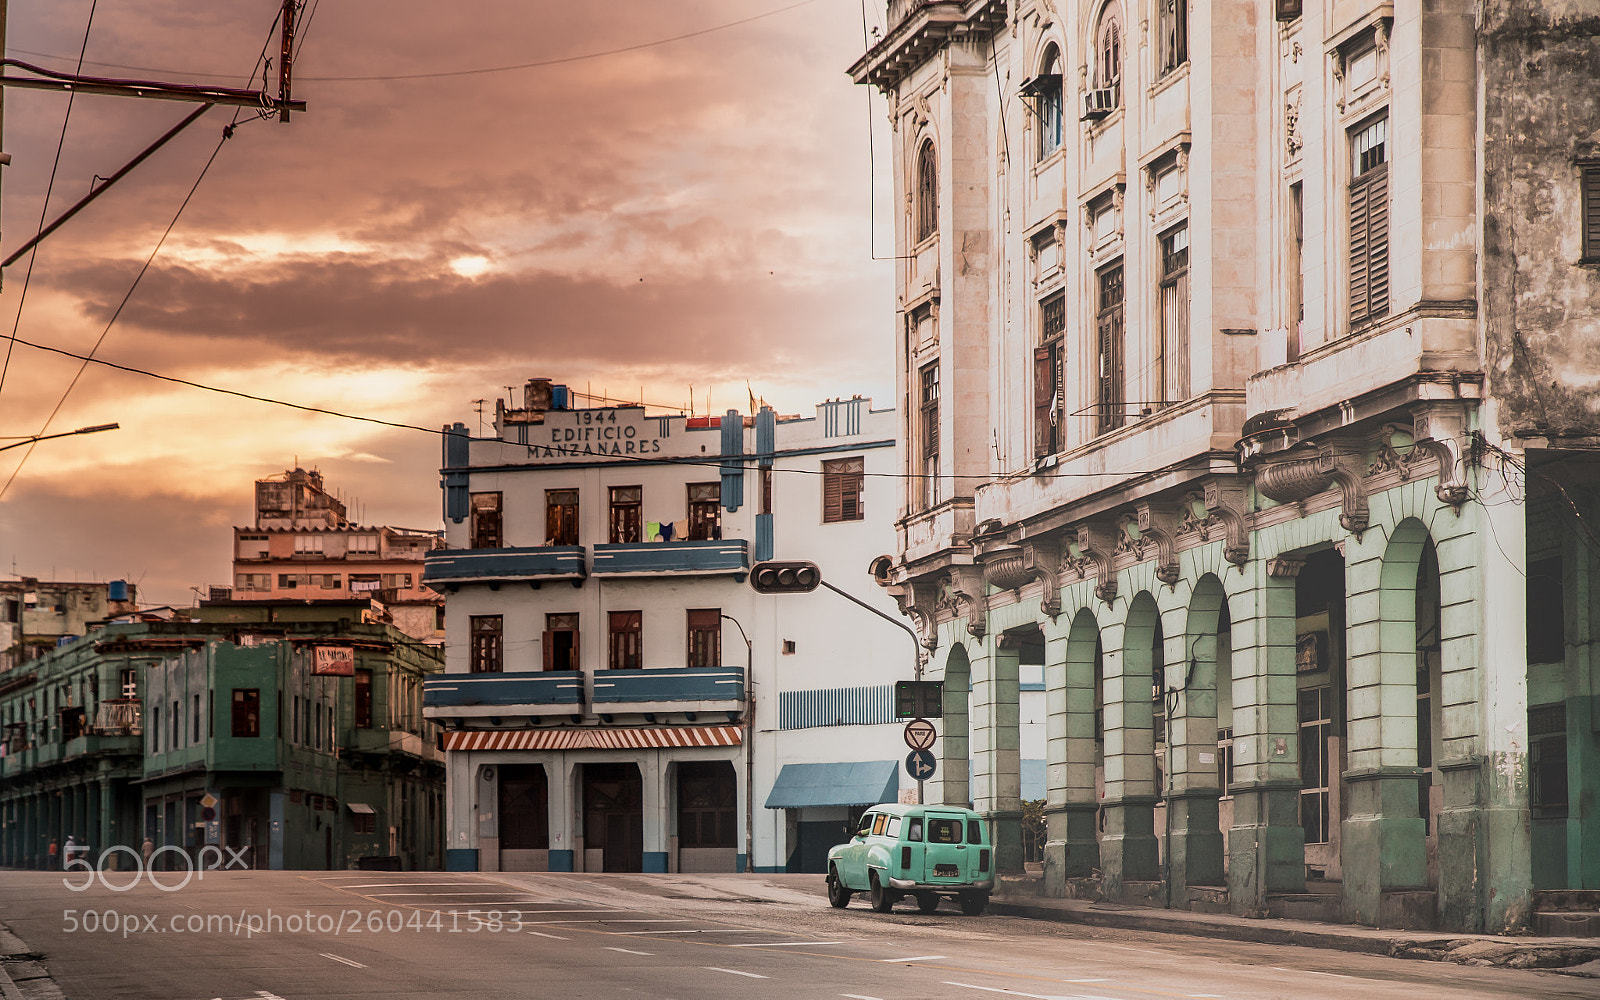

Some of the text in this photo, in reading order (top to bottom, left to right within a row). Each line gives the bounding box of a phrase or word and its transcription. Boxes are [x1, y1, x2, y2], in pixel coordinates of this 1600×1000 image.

[575, 411, 616, 425] 1944
[552, 426, 636, 442] EDIFICIO
[527, 440, 660, 458] MANZANARES
